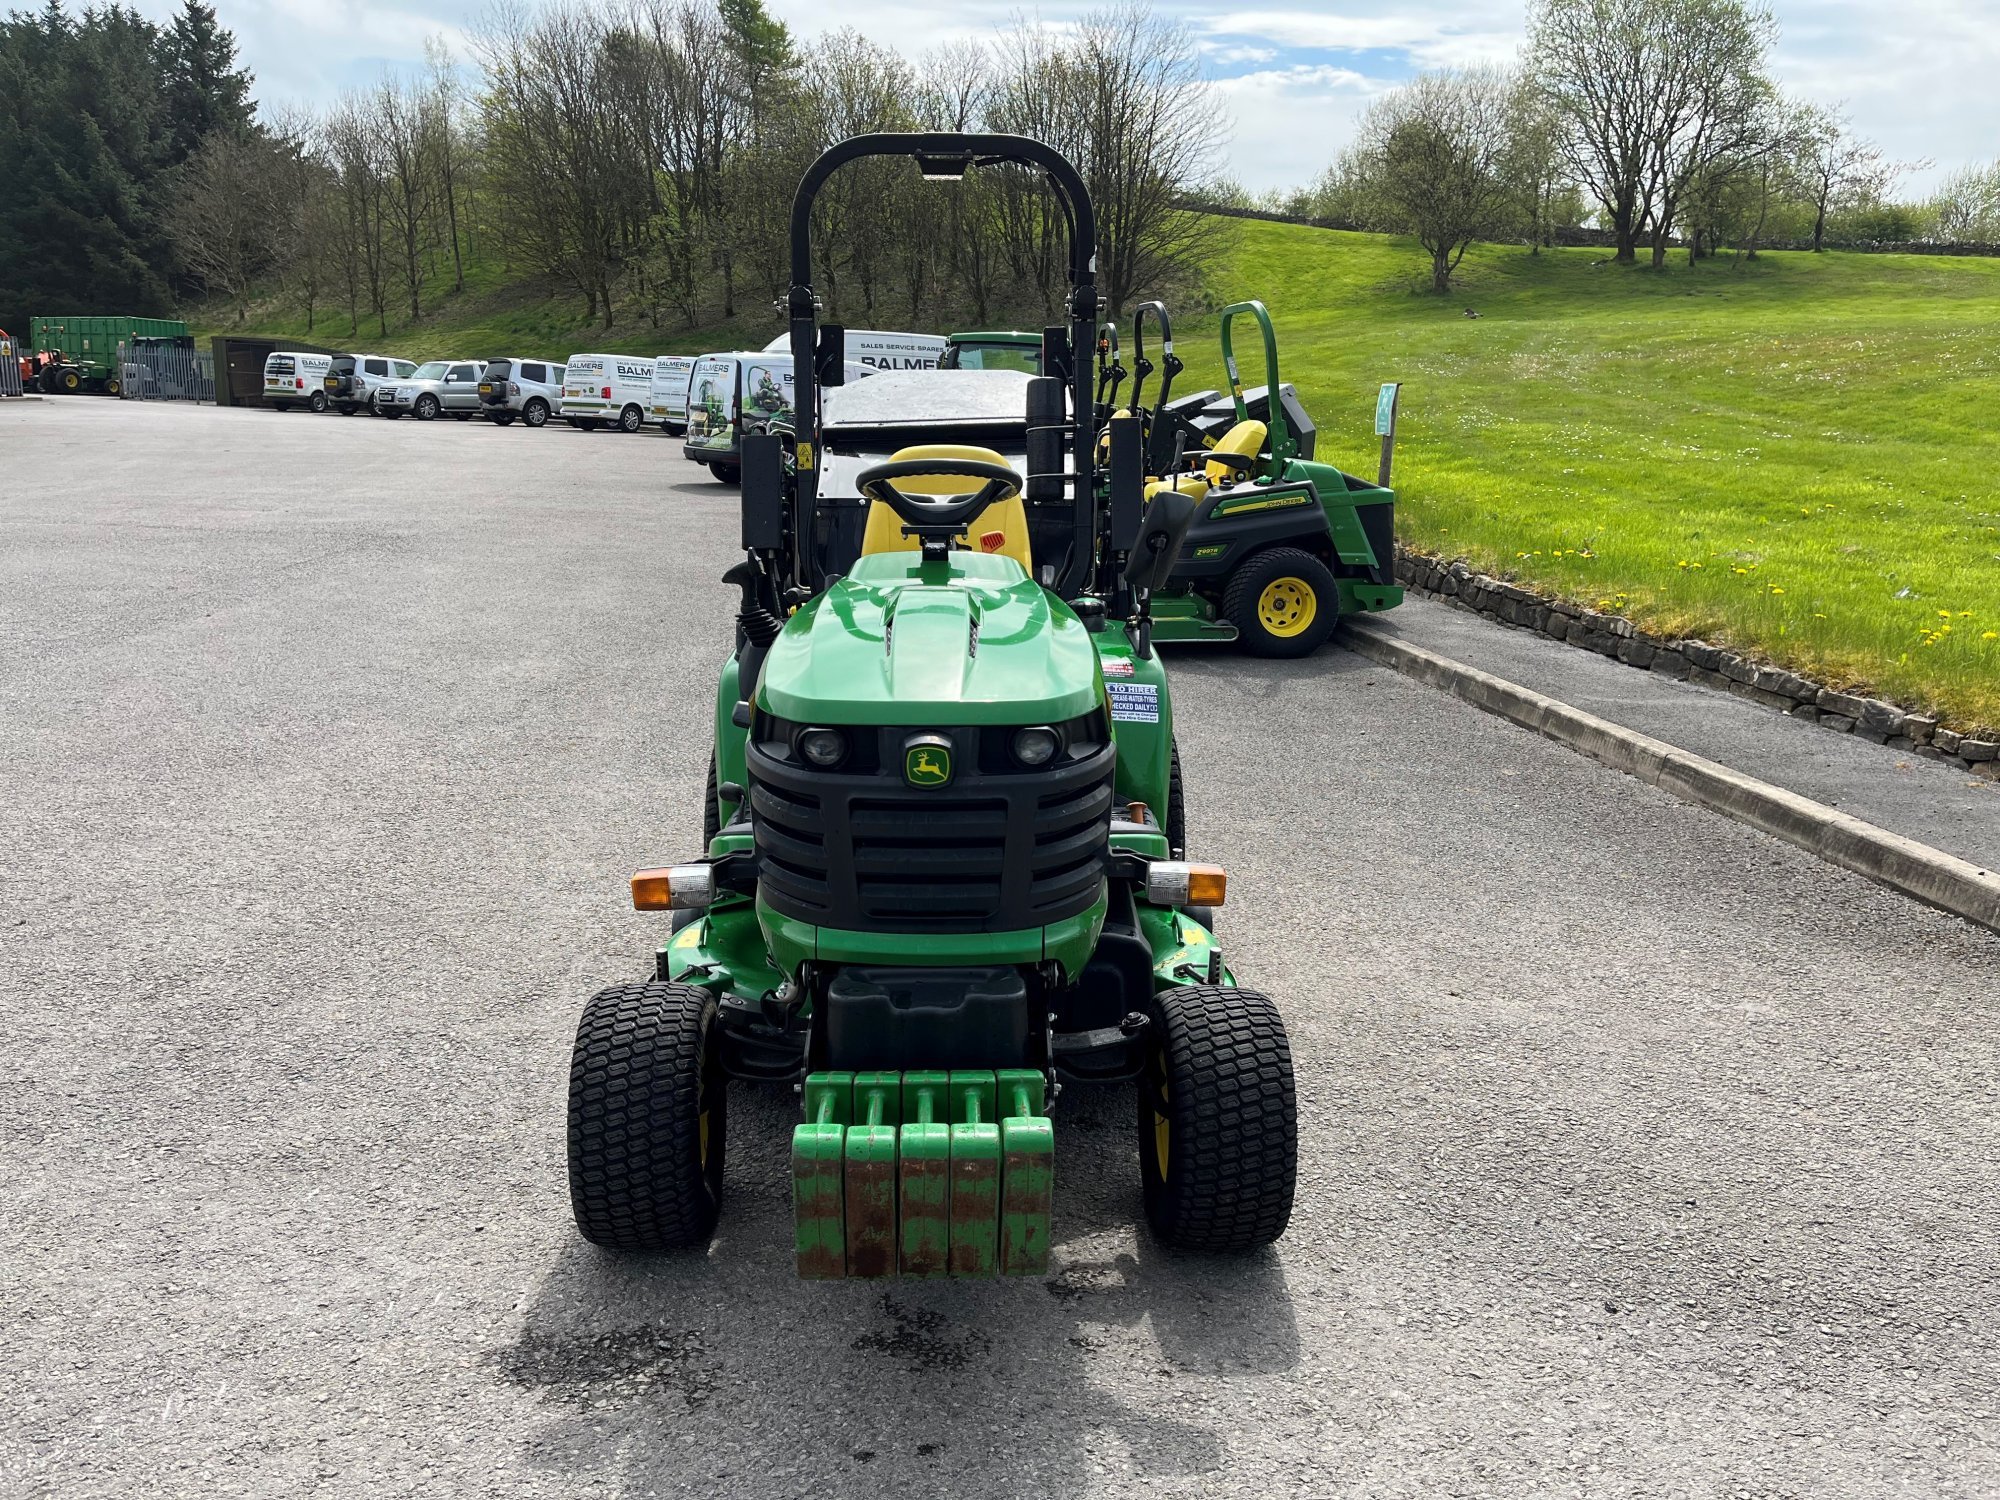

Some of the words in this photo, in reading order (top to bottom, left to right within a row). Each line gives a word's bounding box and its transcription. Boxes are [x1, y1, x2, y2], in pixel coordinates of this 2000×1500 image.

[861, 356, 937, 370] BALME
[617, 365, 653, 376] BALM
[698, 364, 729, 373] BALMERS
[1128, 686, 1156, 694] HIRER
[1134, 703, 1149, 711] DAILY
